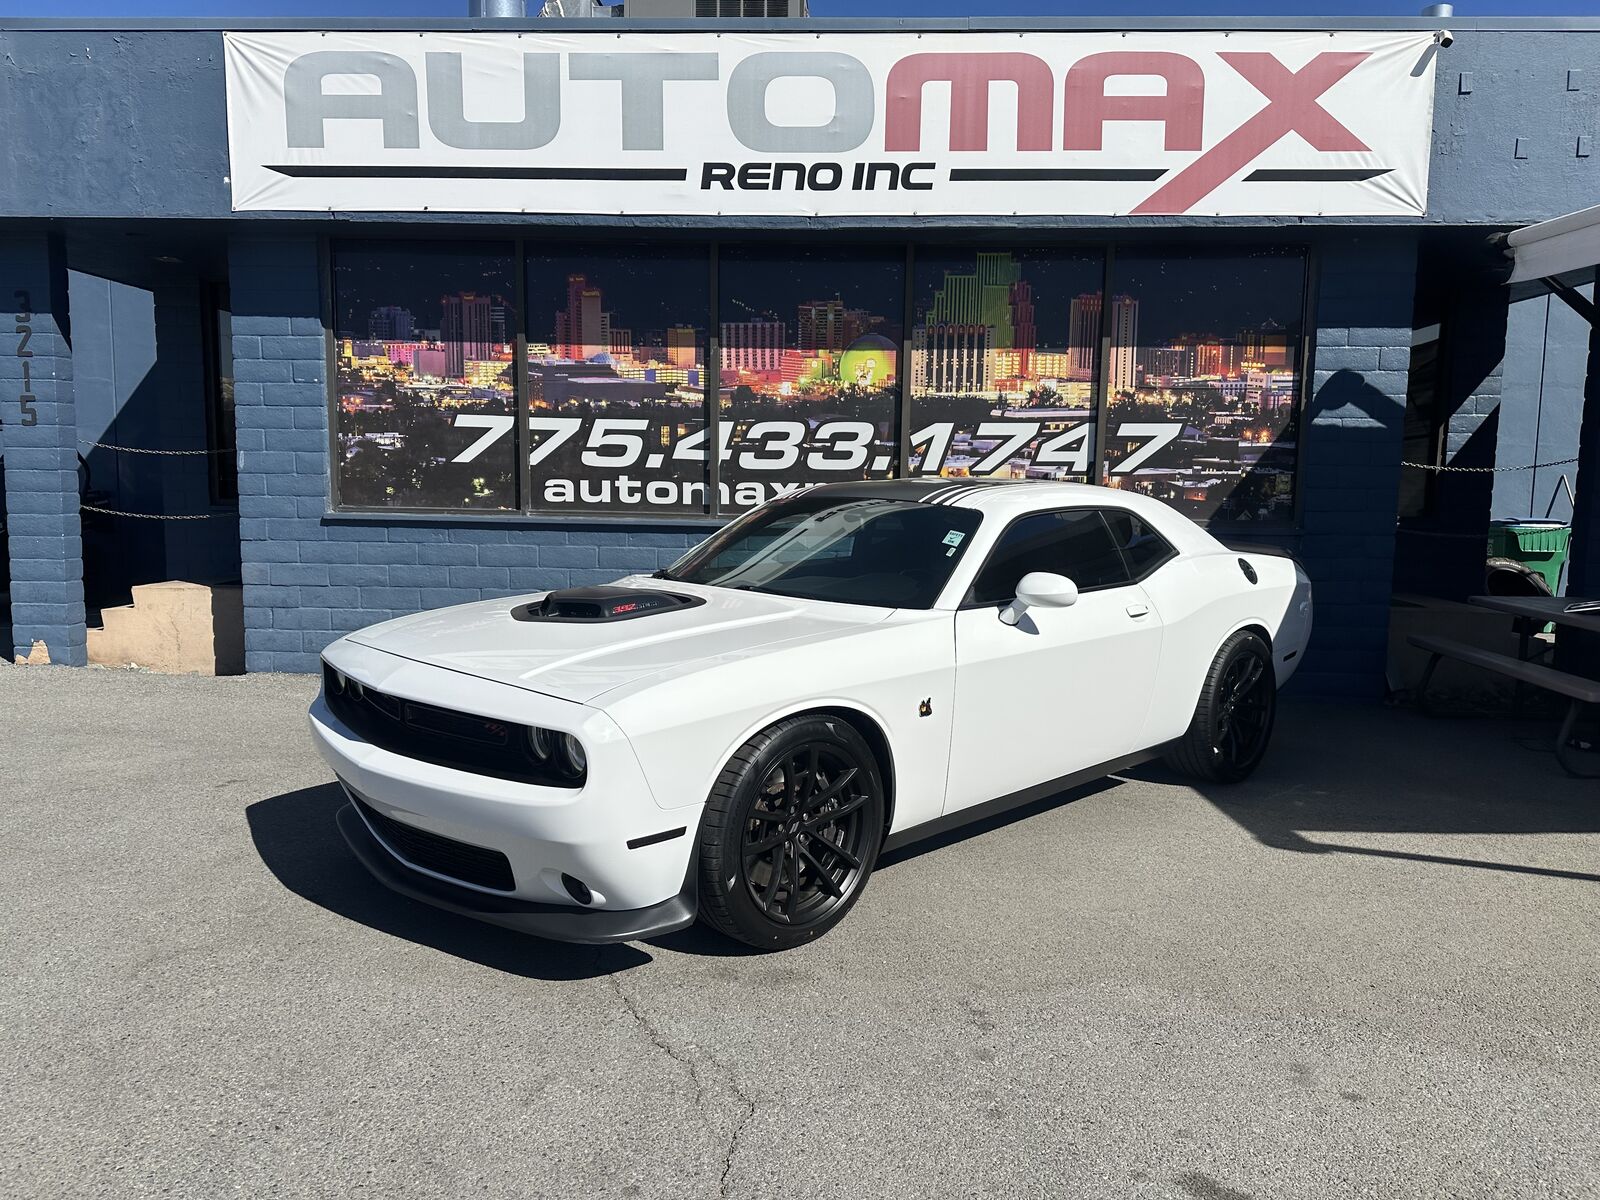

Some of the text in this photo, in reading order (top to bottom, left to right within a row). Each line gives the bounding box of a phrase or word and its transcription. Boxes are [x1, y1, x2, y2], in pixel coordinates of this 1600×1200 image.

[283, 51, 1374, 214] AUTOMAX
[701, 162, 936, 191] RENO INC
[451, 414, 1183, 473] 775.433.1747
[543, 475, 827, 505] automax
